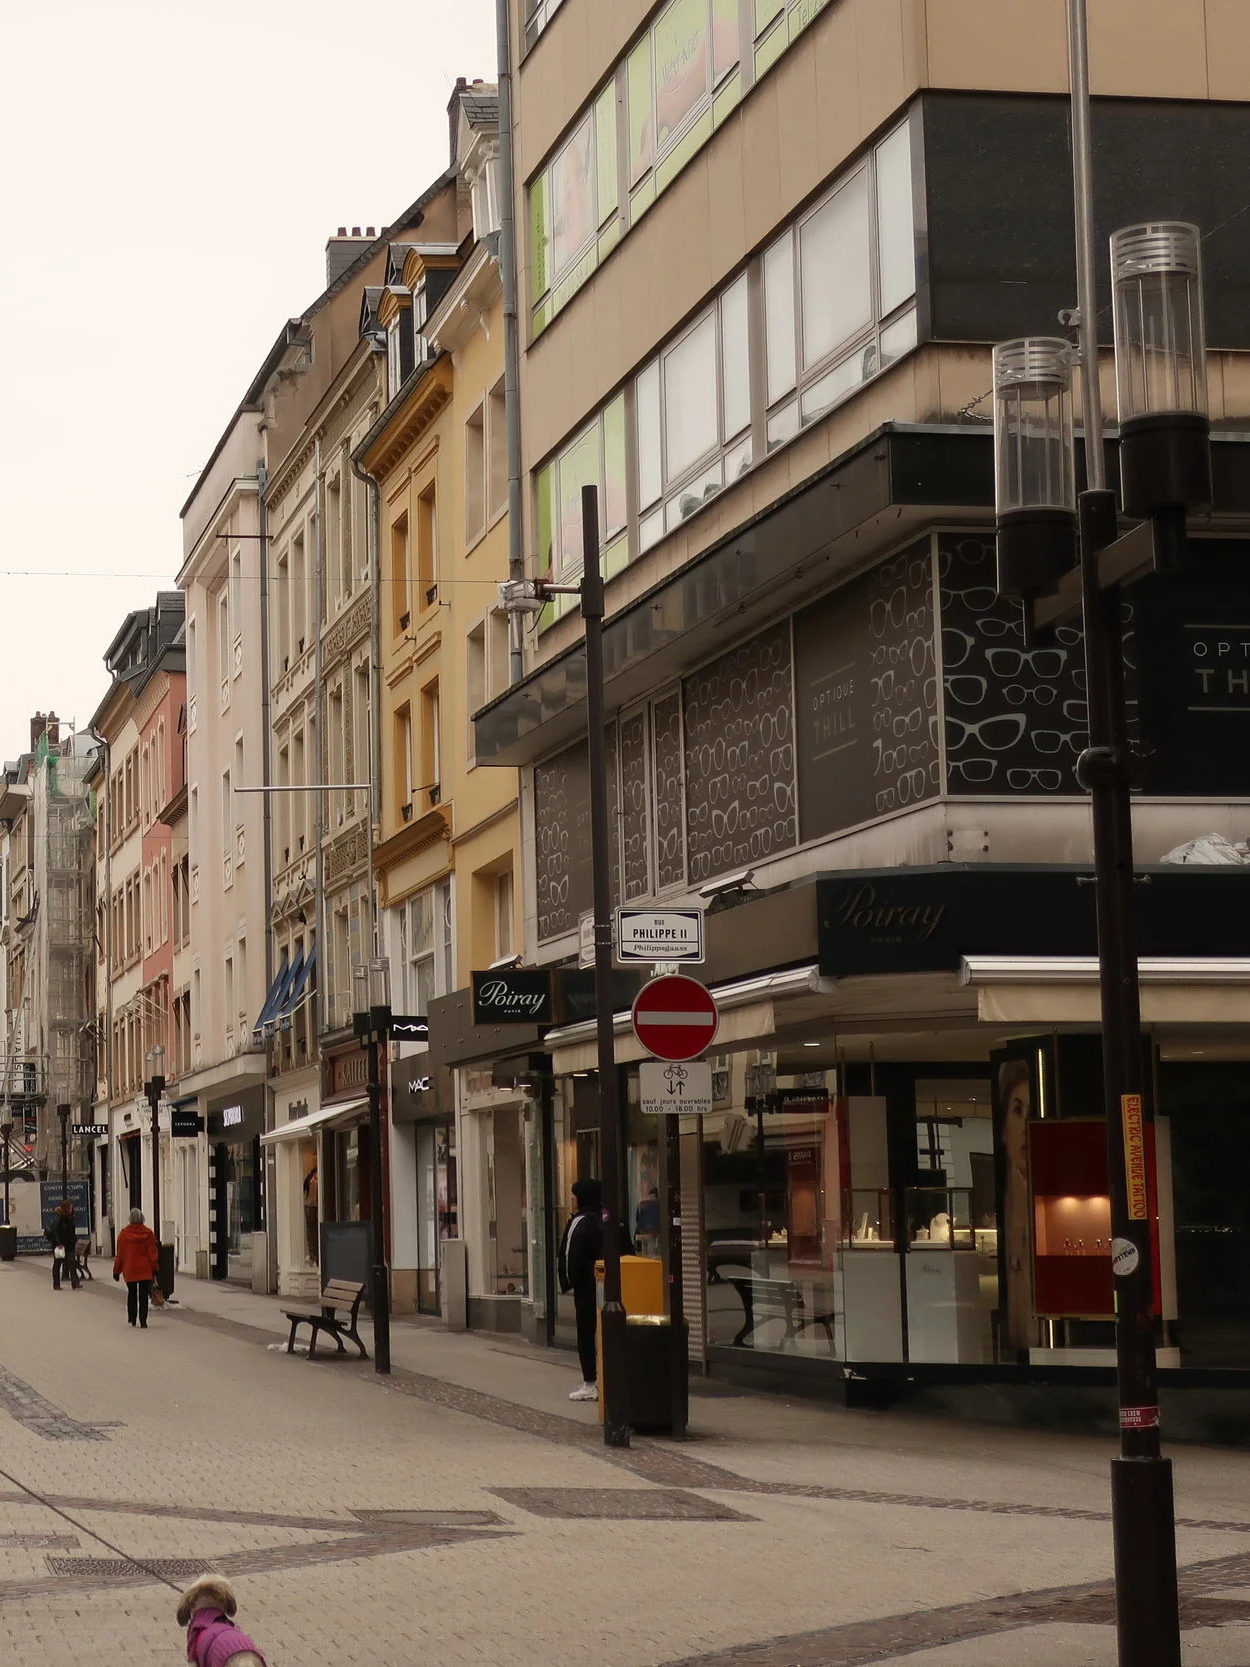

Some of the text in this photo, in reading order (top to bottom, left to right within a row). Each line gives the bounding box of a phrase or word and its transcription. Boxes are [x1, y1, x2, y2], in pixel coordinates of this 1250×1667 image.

[812, 679, 854, 711] OPTIQUE
[813, 705, 855, 744] THILL
[823, 882, 946, 941] Poiray
[632, 928, 687, 939] PHILIPPE II
[633, 944, 688, 953] Philippsgaass
[478, 980, 546, 1015] Poiray
[393, 1023, 429, 1032] MA
[408, 1076, 430, 1094] MAC
[660, 1098, 677, 1106] jours
[679, 1097, 711, 1105] ouvrables
[72, 1125, 107, 1134] LANCEL
[1125, 1096, 1147, 1219] ELECTRIC AVENUE TATTOO
